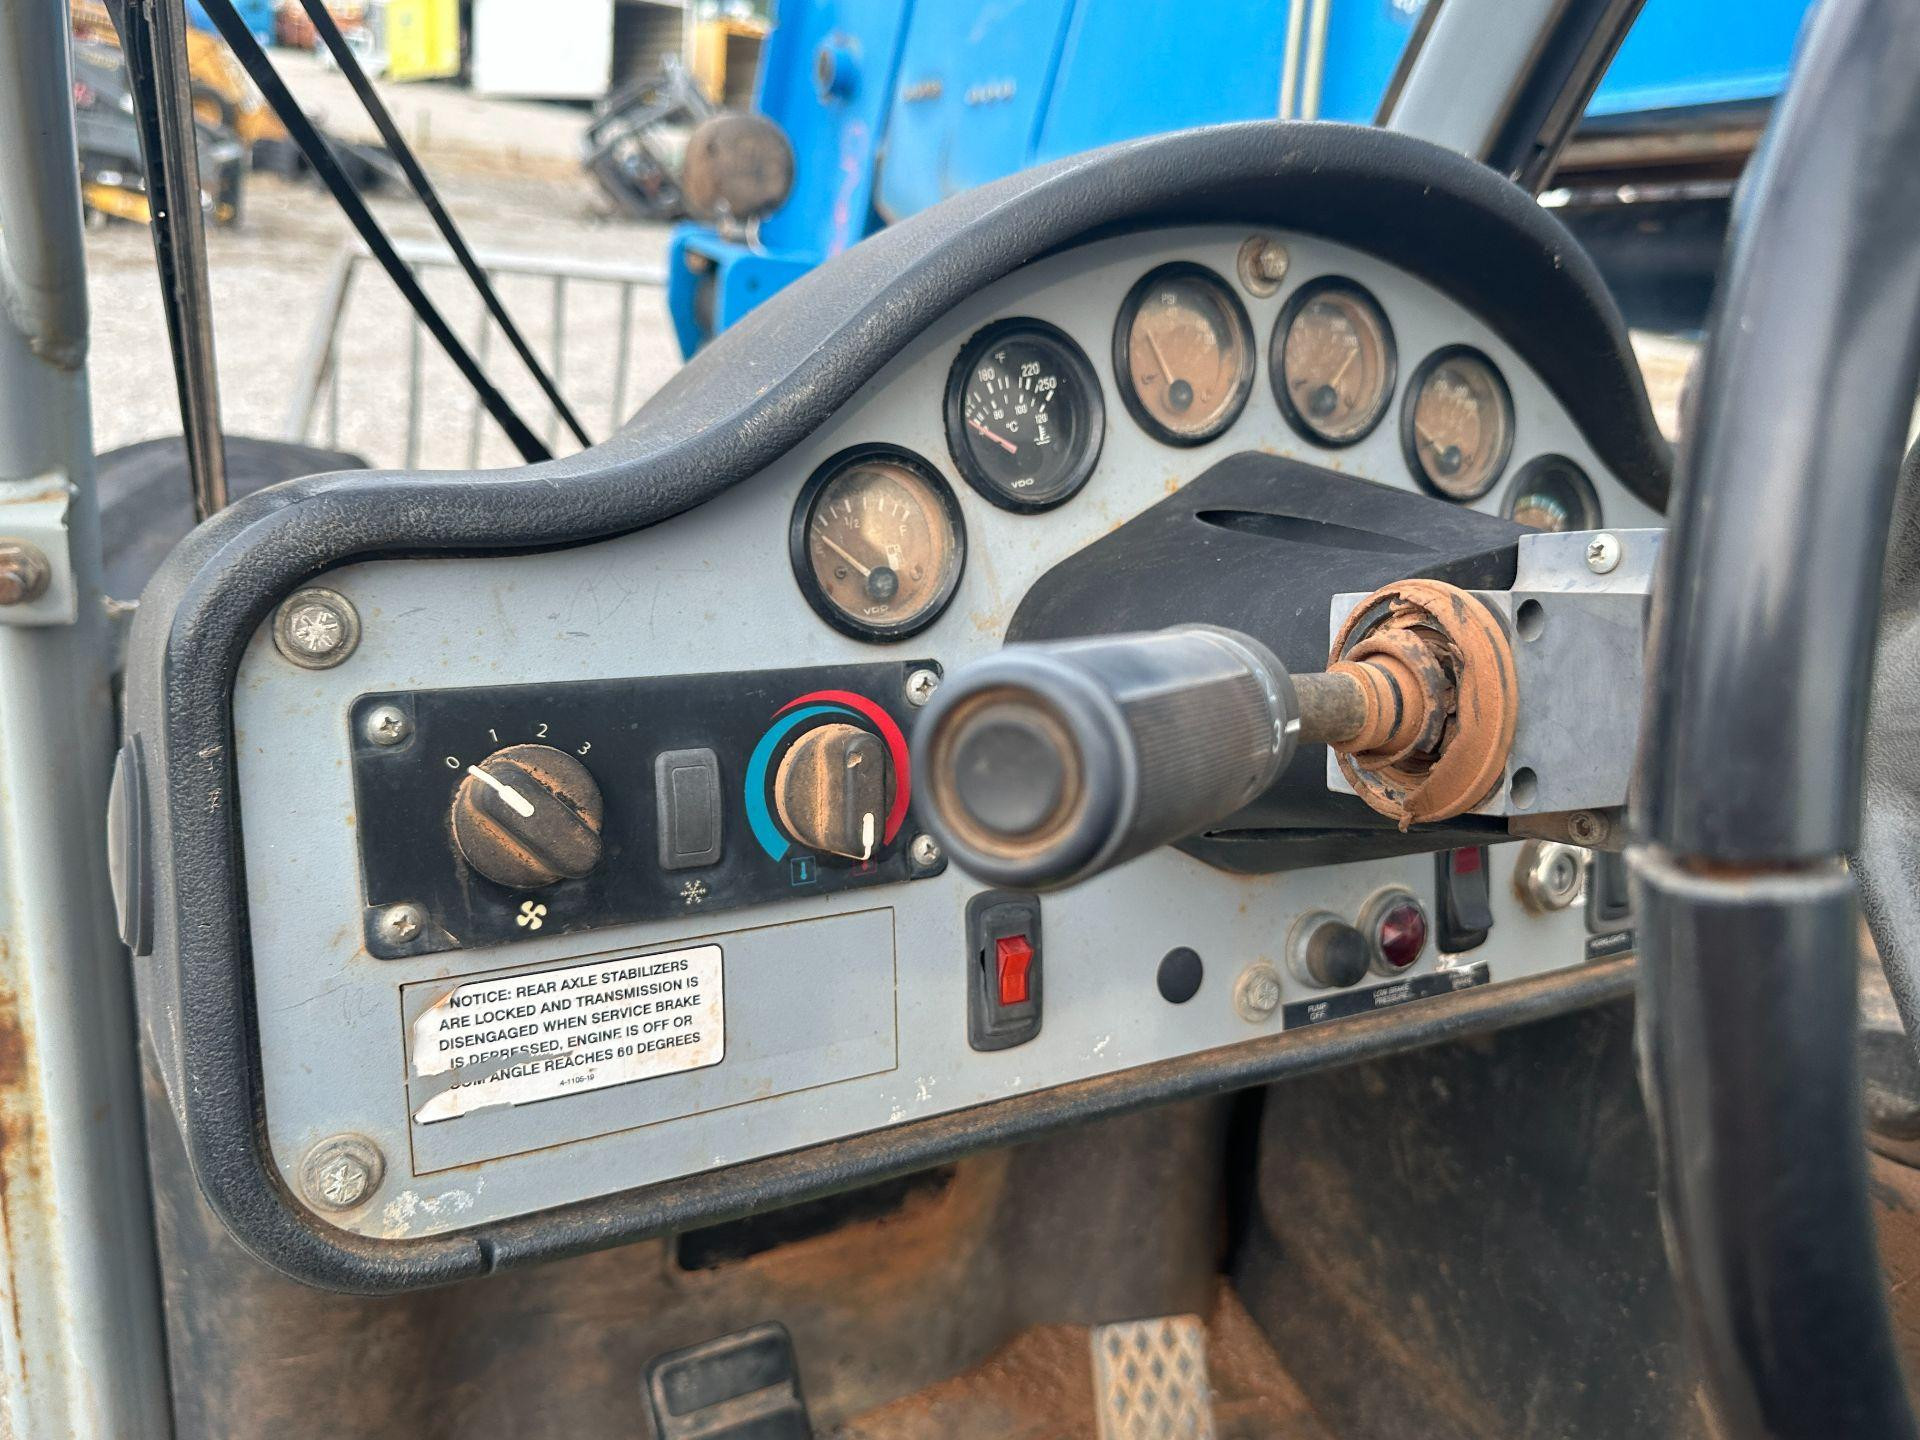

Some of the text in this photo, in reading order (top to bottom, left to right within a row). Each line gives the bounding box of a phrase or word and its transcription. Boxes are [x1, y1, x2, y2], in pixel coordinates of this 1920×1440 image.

[978, 367, 995, 382] 180
[1021, 361, 1040, 377] 220
[1038, 377, 1057, 392] 250
[1015, 404, 1027, 415] 100
[1035, 412, 1048, 424] 120
[1011, 478, 1034, 489] VDO
[863, 605, 889, 616] VDO
[488, 728, 498, 742] 1
[536, 723, 548, 738] 2
[577, 741, 591, 755] 3
[446, 756, 460, 769] 0
[450, 959, 688, 1009] NOTICE: REAR AXLE STABILIZERS
[439, 976, 699, 1031] ARE LOCKED AND TRANSMISSION IS
[439, 994, 701, 1051] DISENGAGED WHEN SERVICE BRAKE
[450, 1056, 464, 1070] IS
[567, 1027, 622, 1048] ENGINE
[626, 1025, 639, 1037] IS
[643, 1019, 671, 1033] OFF
[673, 1015, 693, 1028] OR
[490, 1032, 701, 1083] ANGLE REACHES 60 DEGREES
